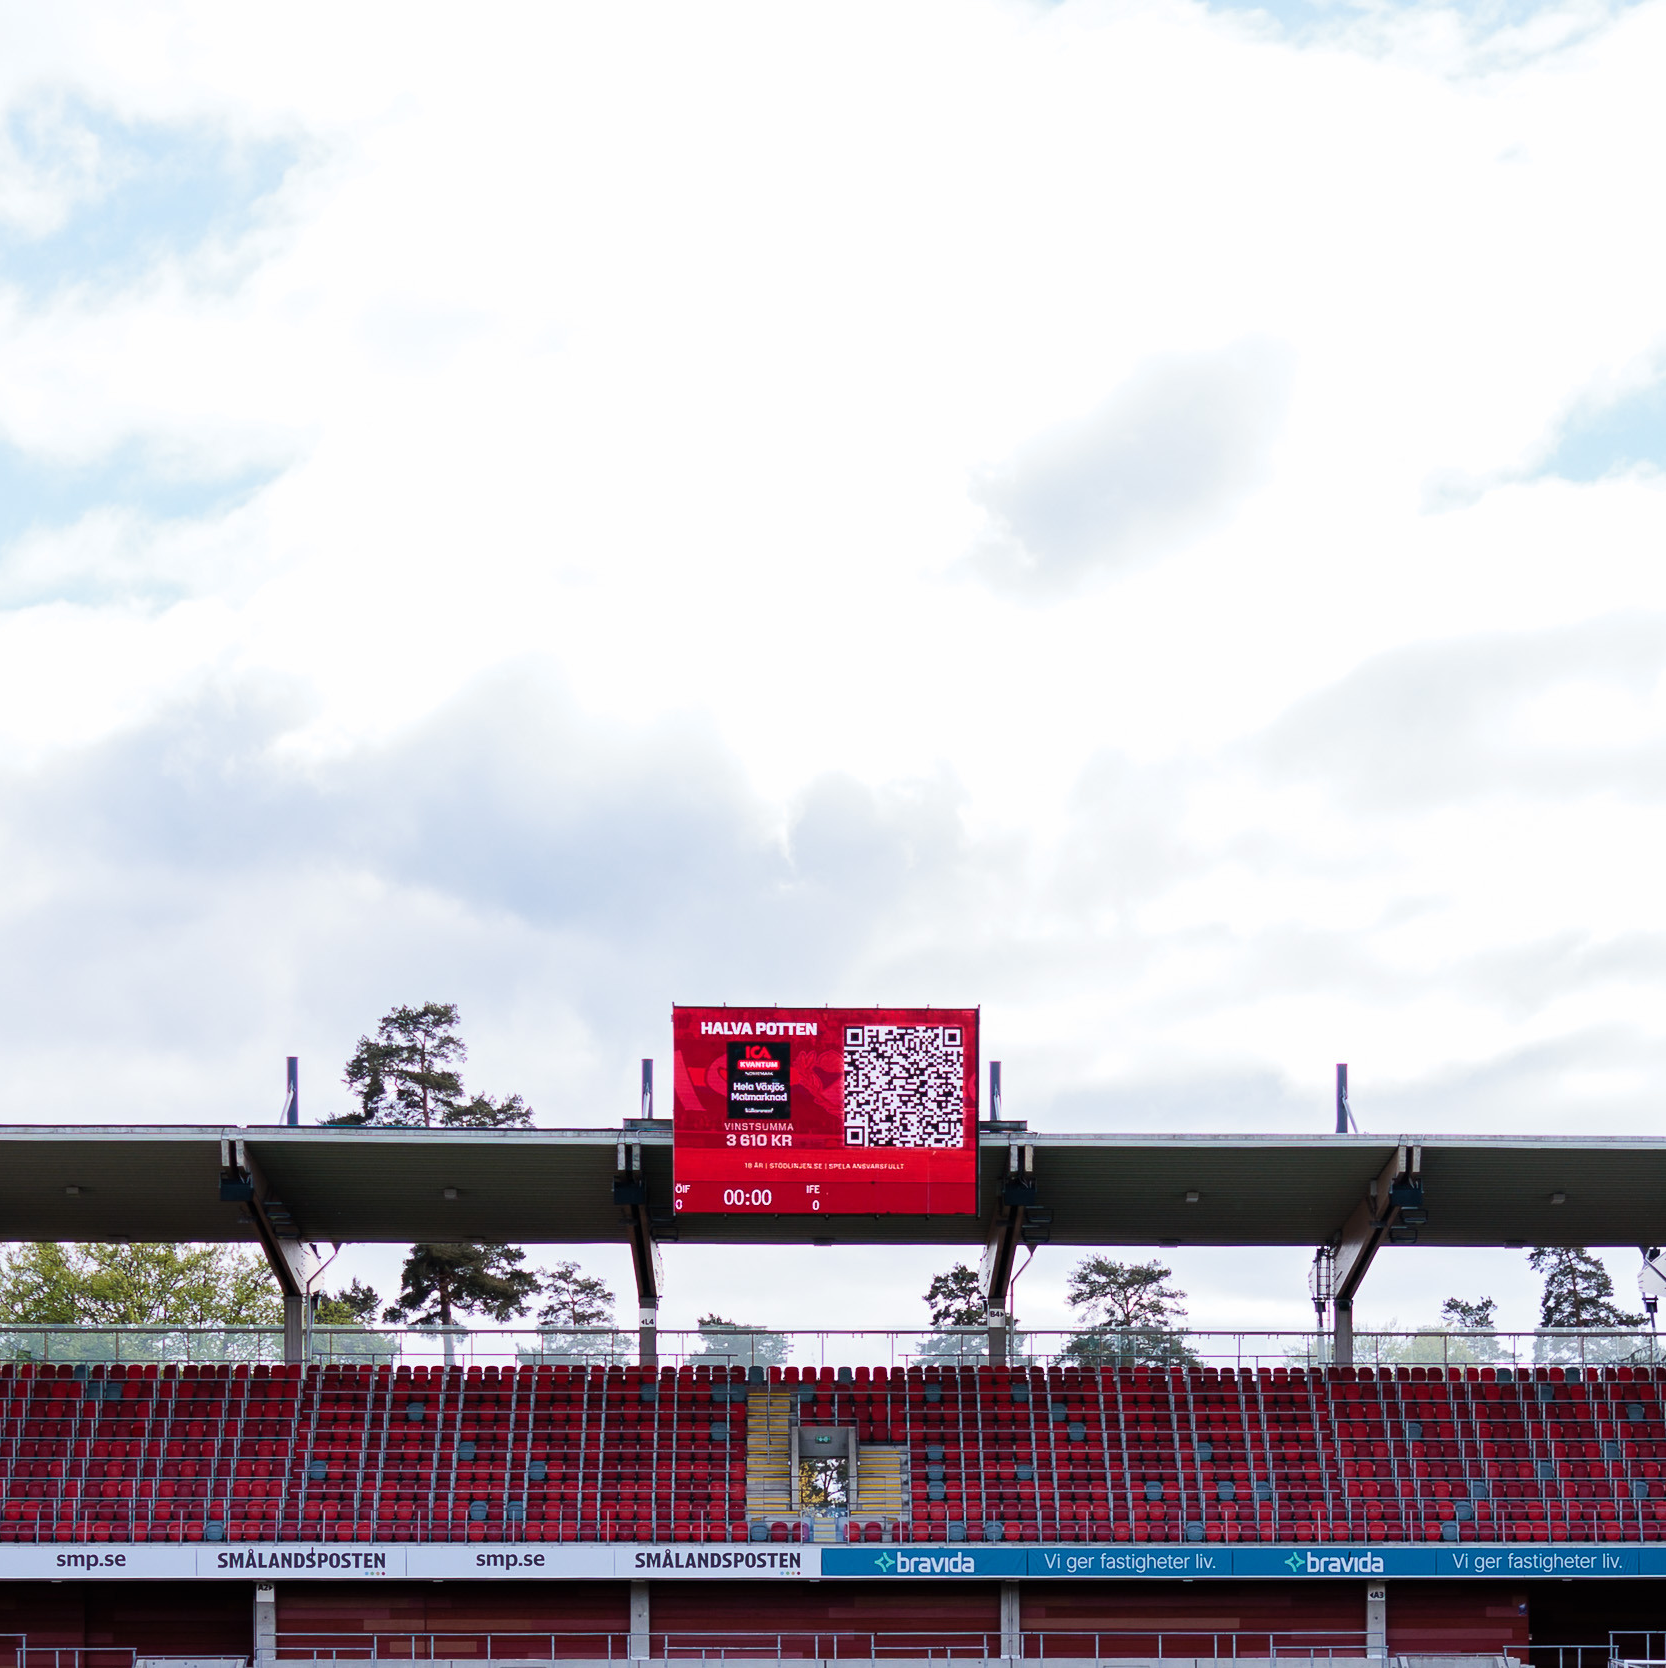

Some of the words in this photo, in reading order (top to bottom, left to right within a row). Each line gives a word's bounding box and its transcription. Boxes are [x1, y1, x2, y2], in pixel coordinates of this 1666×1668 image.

[701, 1021, 753, 1035] HALVA
[756, 1022, 817, 1036] POTTEN
[745, 1045, 771, 1059] ICA
[733, 1082, 754, 1091] Hela
[755, 1082, 785, 1093] Växjös
[731, 1092, 788, 1102] Matmarknad
[724, 1123, 794, 1131] VINSTSUMMA
[726, 1134, 736, 1147] 3
[740, 1134, 768, 1147] 610
[771, 1134, 793, 1147] KR
[828, 1162, 851, 1170] SPELA
[724, 1189, 772, 1206] 00:00
[806, 1185, 820, 1194] IFE
[812, 1200, 820, 1211] 0
[56, 1552, 127, 1570] smp.se
[217, 1548, 386, 1569] SMÅLANDSPOSTEN
[475, 1552, 545, 1570] smp.se
[634, 1548, 801, 1569] SMÅLANDSPOSTEN
[896, 1551, 975, 1573] bravida
[1044, 1553, 1061, 1569] Vi
[1066, 1557, 1095, 1573] ger
[1100, 1552, 1191, 1573] fastigheter
[1195, 1552, 1216, 1569] liv.
[1307, 1551, 1384, 1573] bravida
[1452, 1553, 1469, 1569] Vi
[1474, 1557, 1503, 1573] ger
[1507, 1552, 1597, 1573] fastigheter
[1602, 1552, 1623, 1569] liv.
